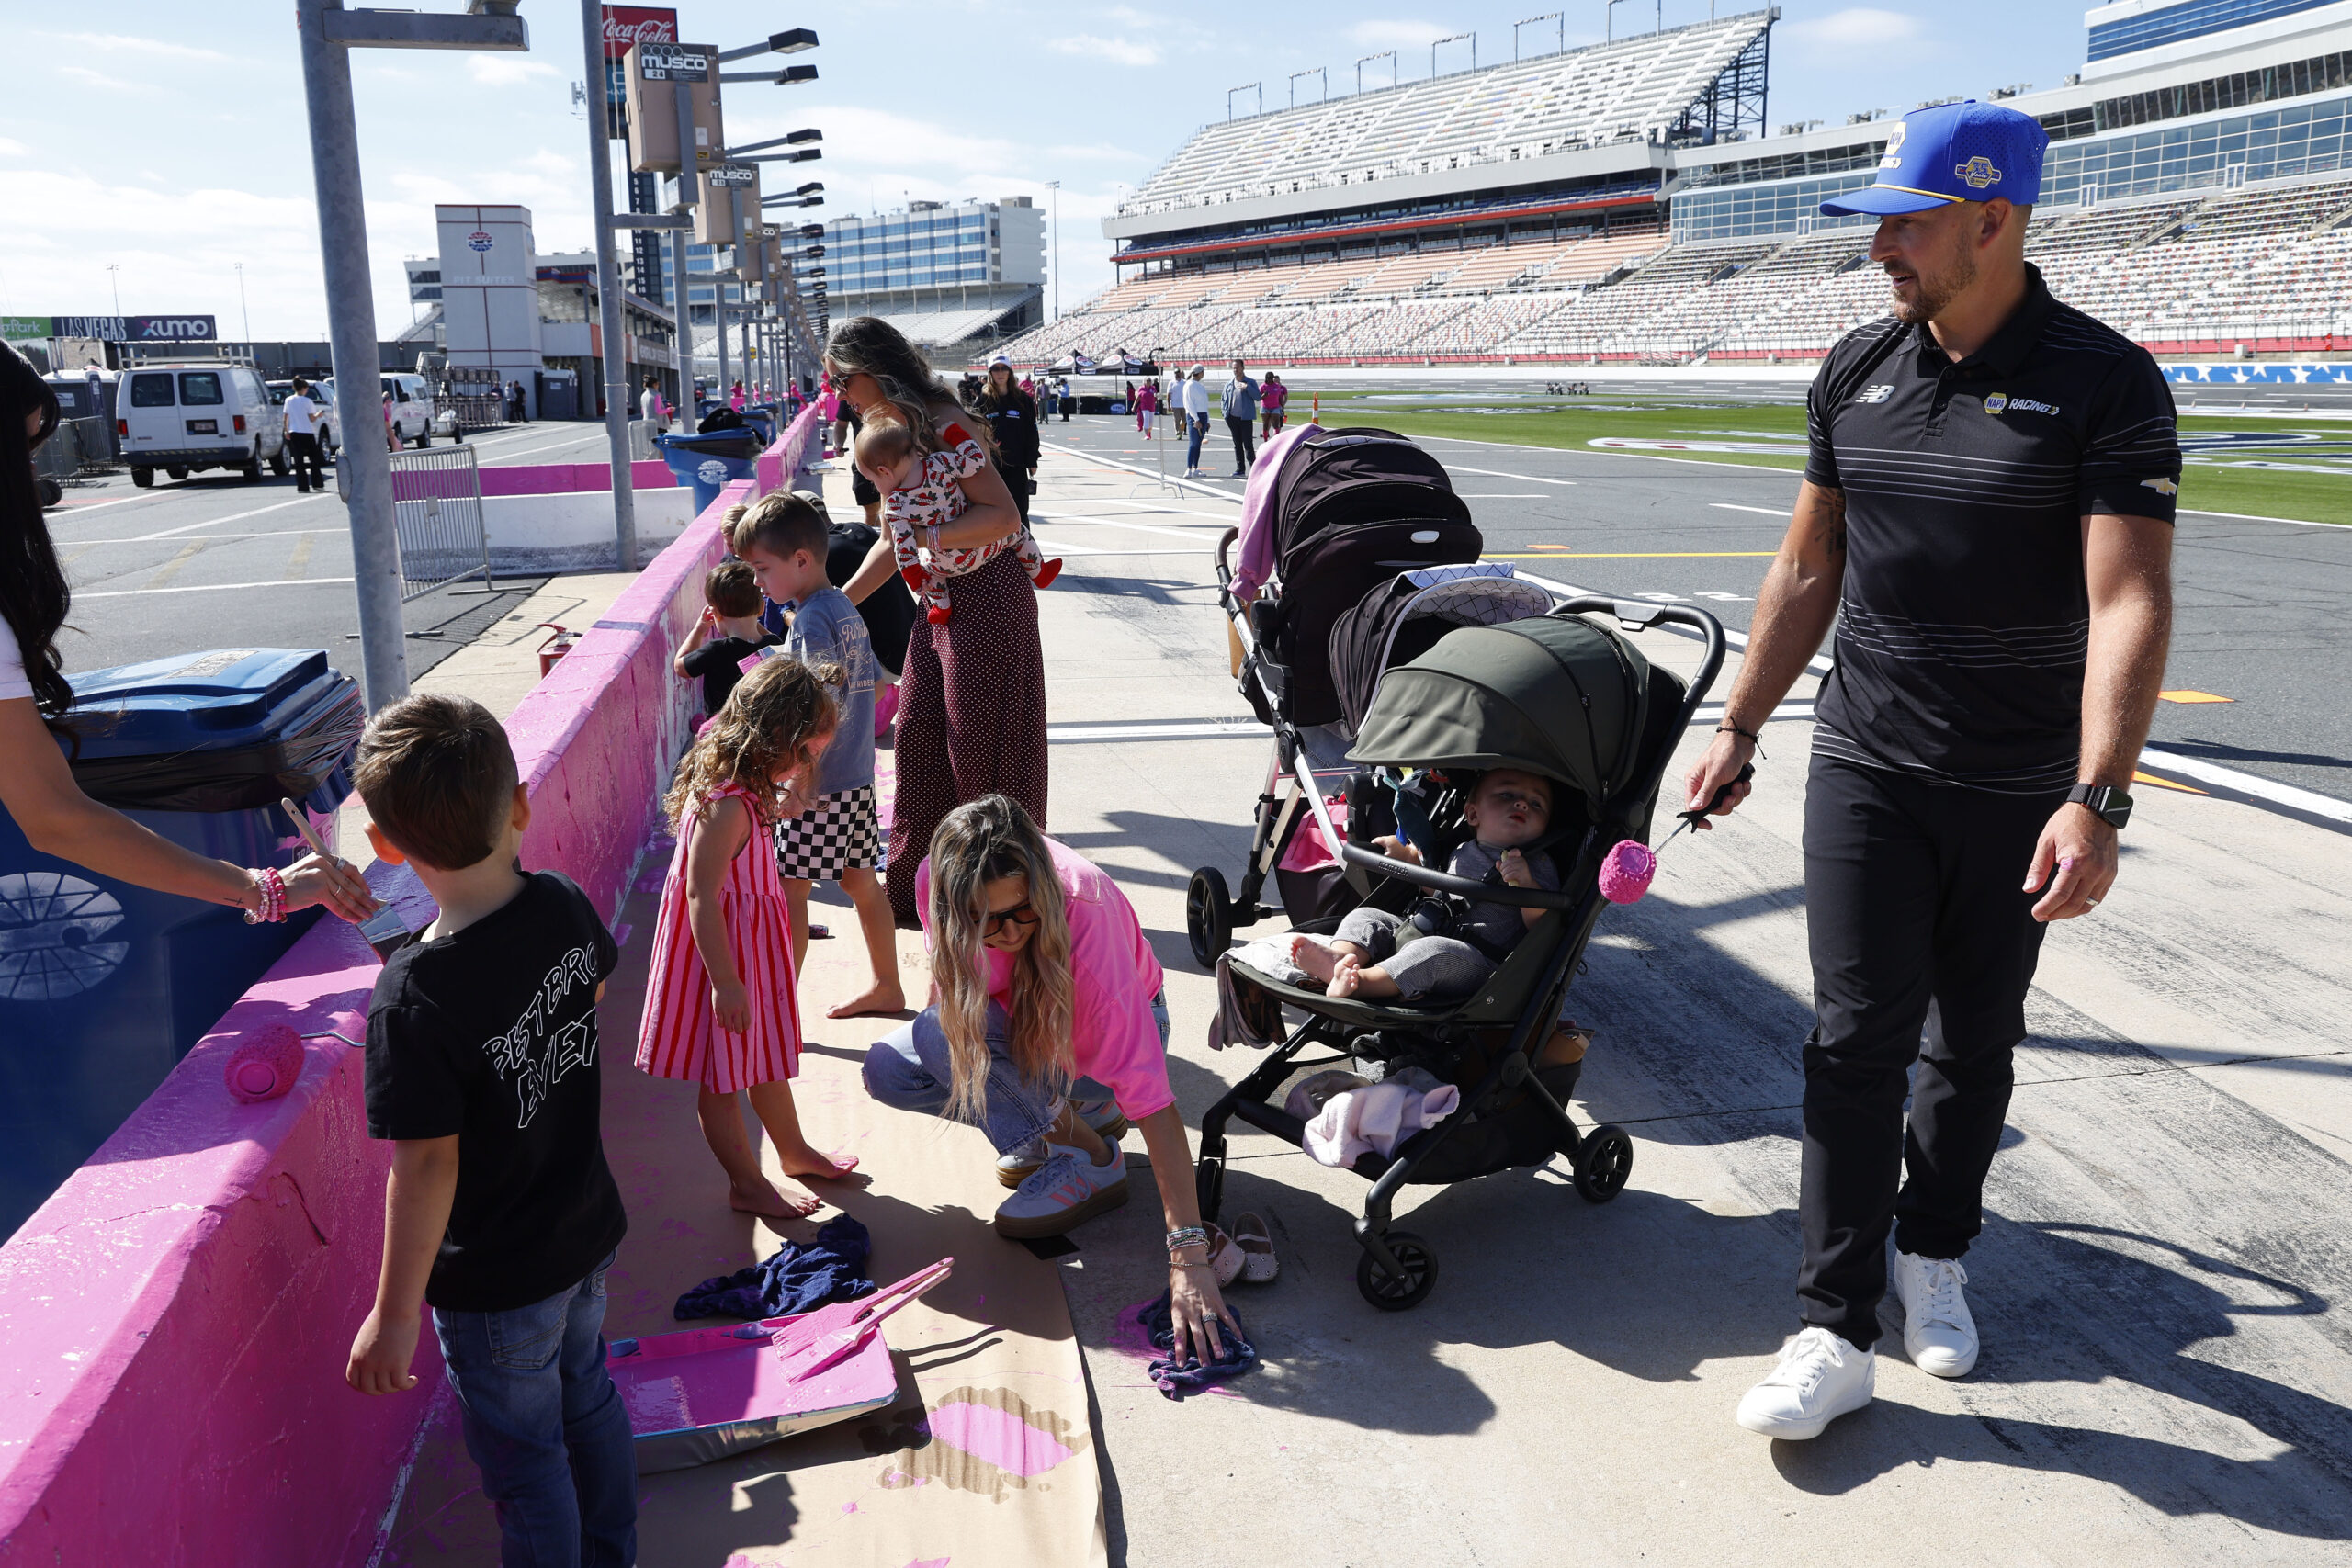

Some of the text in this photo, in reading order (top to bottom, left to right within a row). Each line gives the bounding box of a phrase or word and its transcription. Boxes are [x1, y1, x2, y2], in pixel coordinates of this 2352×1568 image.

[61, 318, 127, 341] LAS VEGAS
[1986, 397, 2051, 413] NAPA RACING
[297, 844, 314, 860] TRA
[482, 990, 542, 1081] BEST
